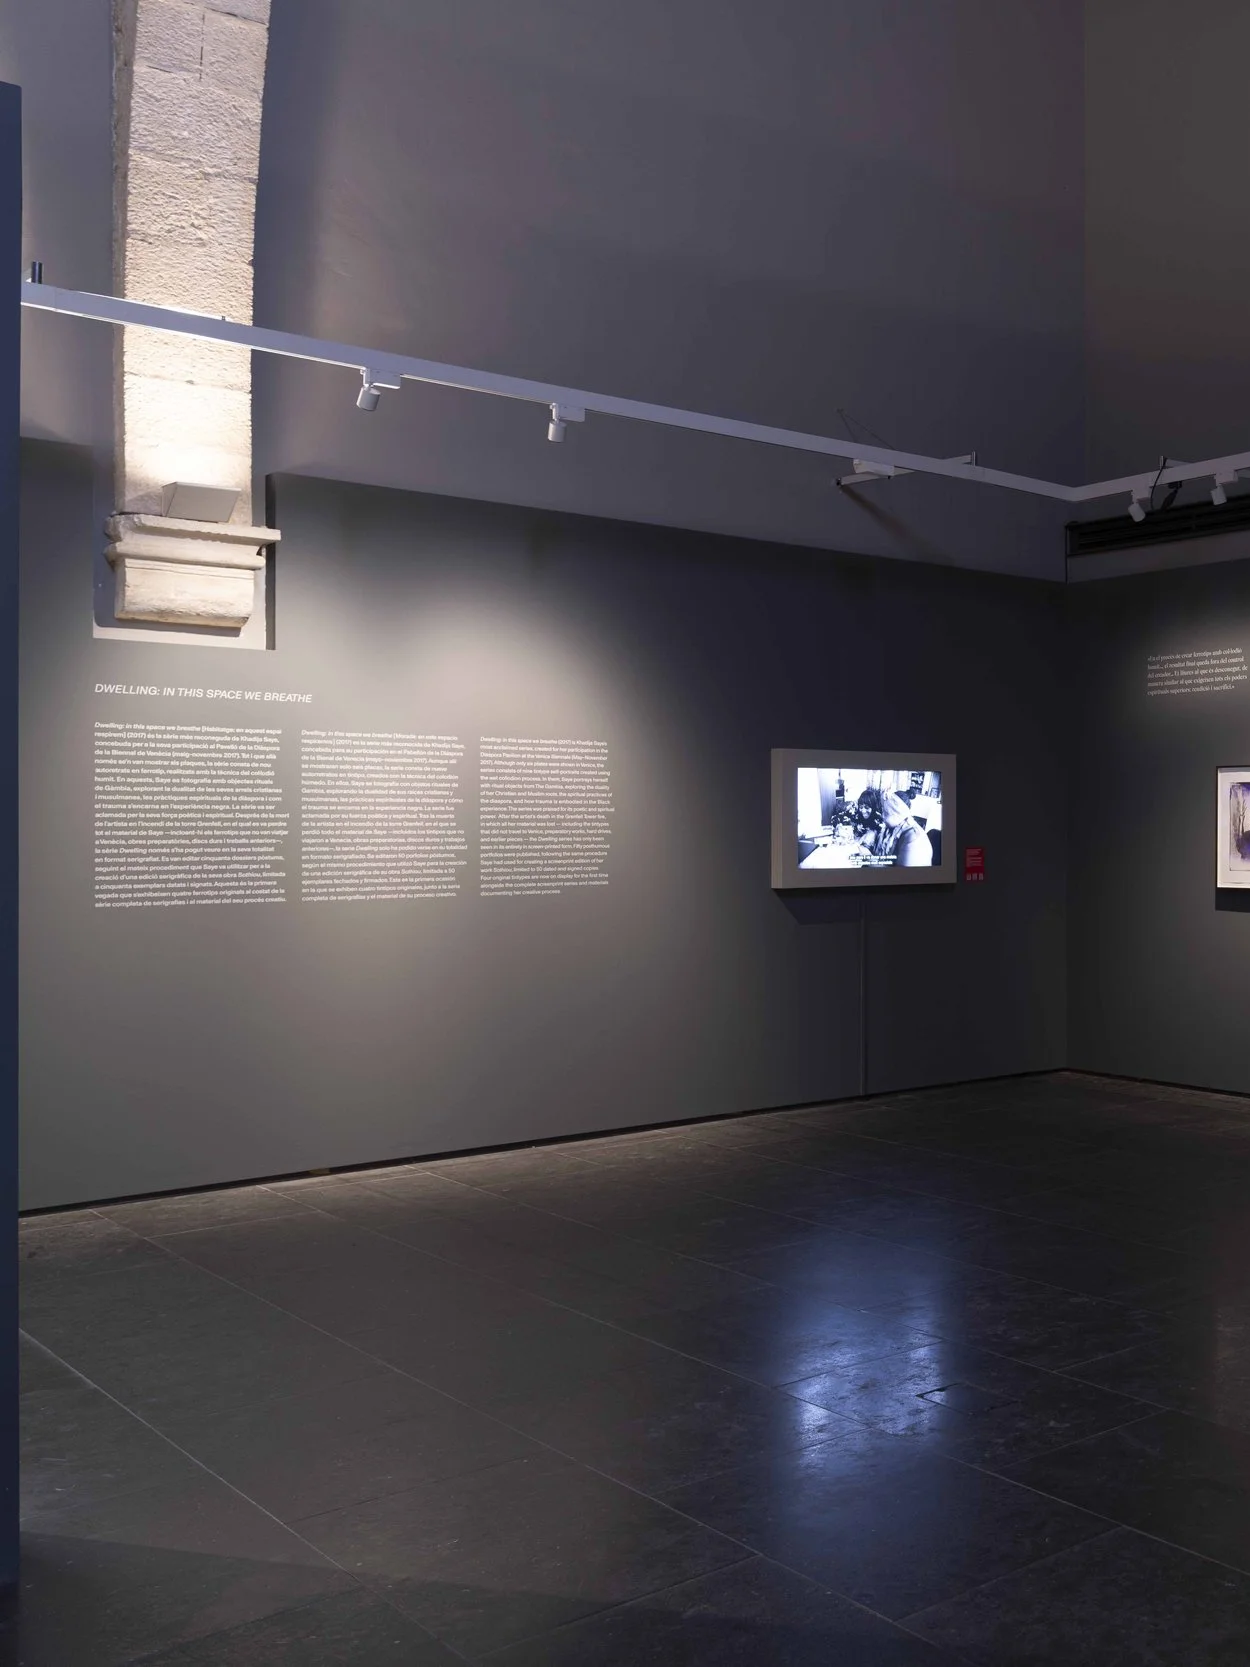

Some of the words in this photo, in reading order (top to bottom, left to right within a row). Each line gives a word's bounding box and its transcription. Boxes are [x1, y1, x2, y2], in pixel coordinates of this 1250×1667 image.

[95, 684, 160, 695] DWELLING:
[163, 687, 175, 696] IN
[178, 688, 203, 697] THIS
[206, 689, 242, 699] SPACE
[245, 691, 261, 700] WE
[264, 692, 312, 703] BREATHE
